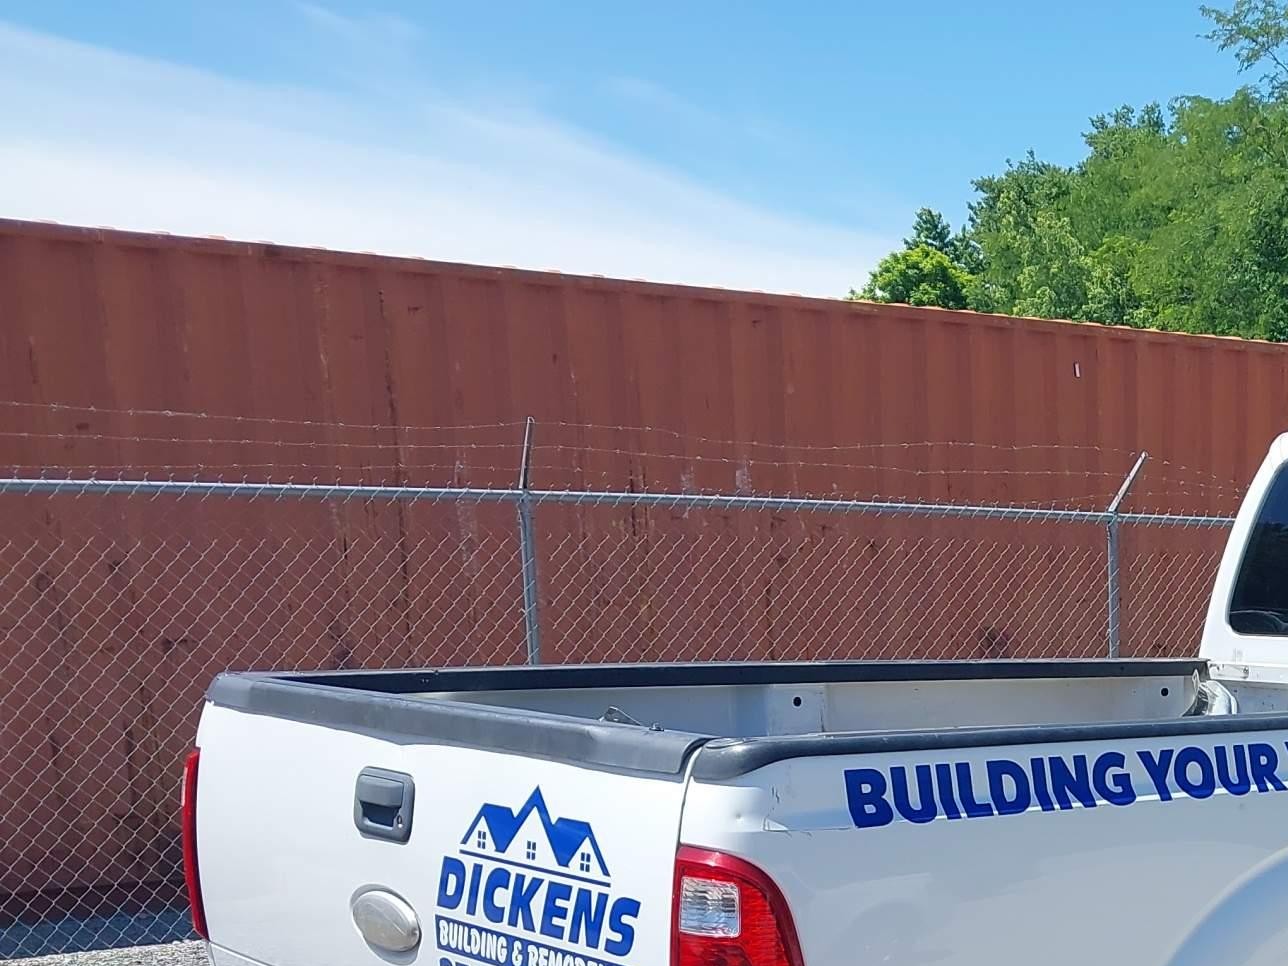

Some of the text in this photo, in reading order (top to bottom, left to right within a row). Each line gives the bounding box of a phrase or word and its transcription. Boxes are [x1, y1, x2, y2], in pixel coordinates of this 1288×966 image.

[844, 751, 1136, 829] BUILDING
[1137, 743, 1288, 801] YOUR
[437, 856, 641, 957] DICKENS
[439, 919, 507, 964] BUILDING
